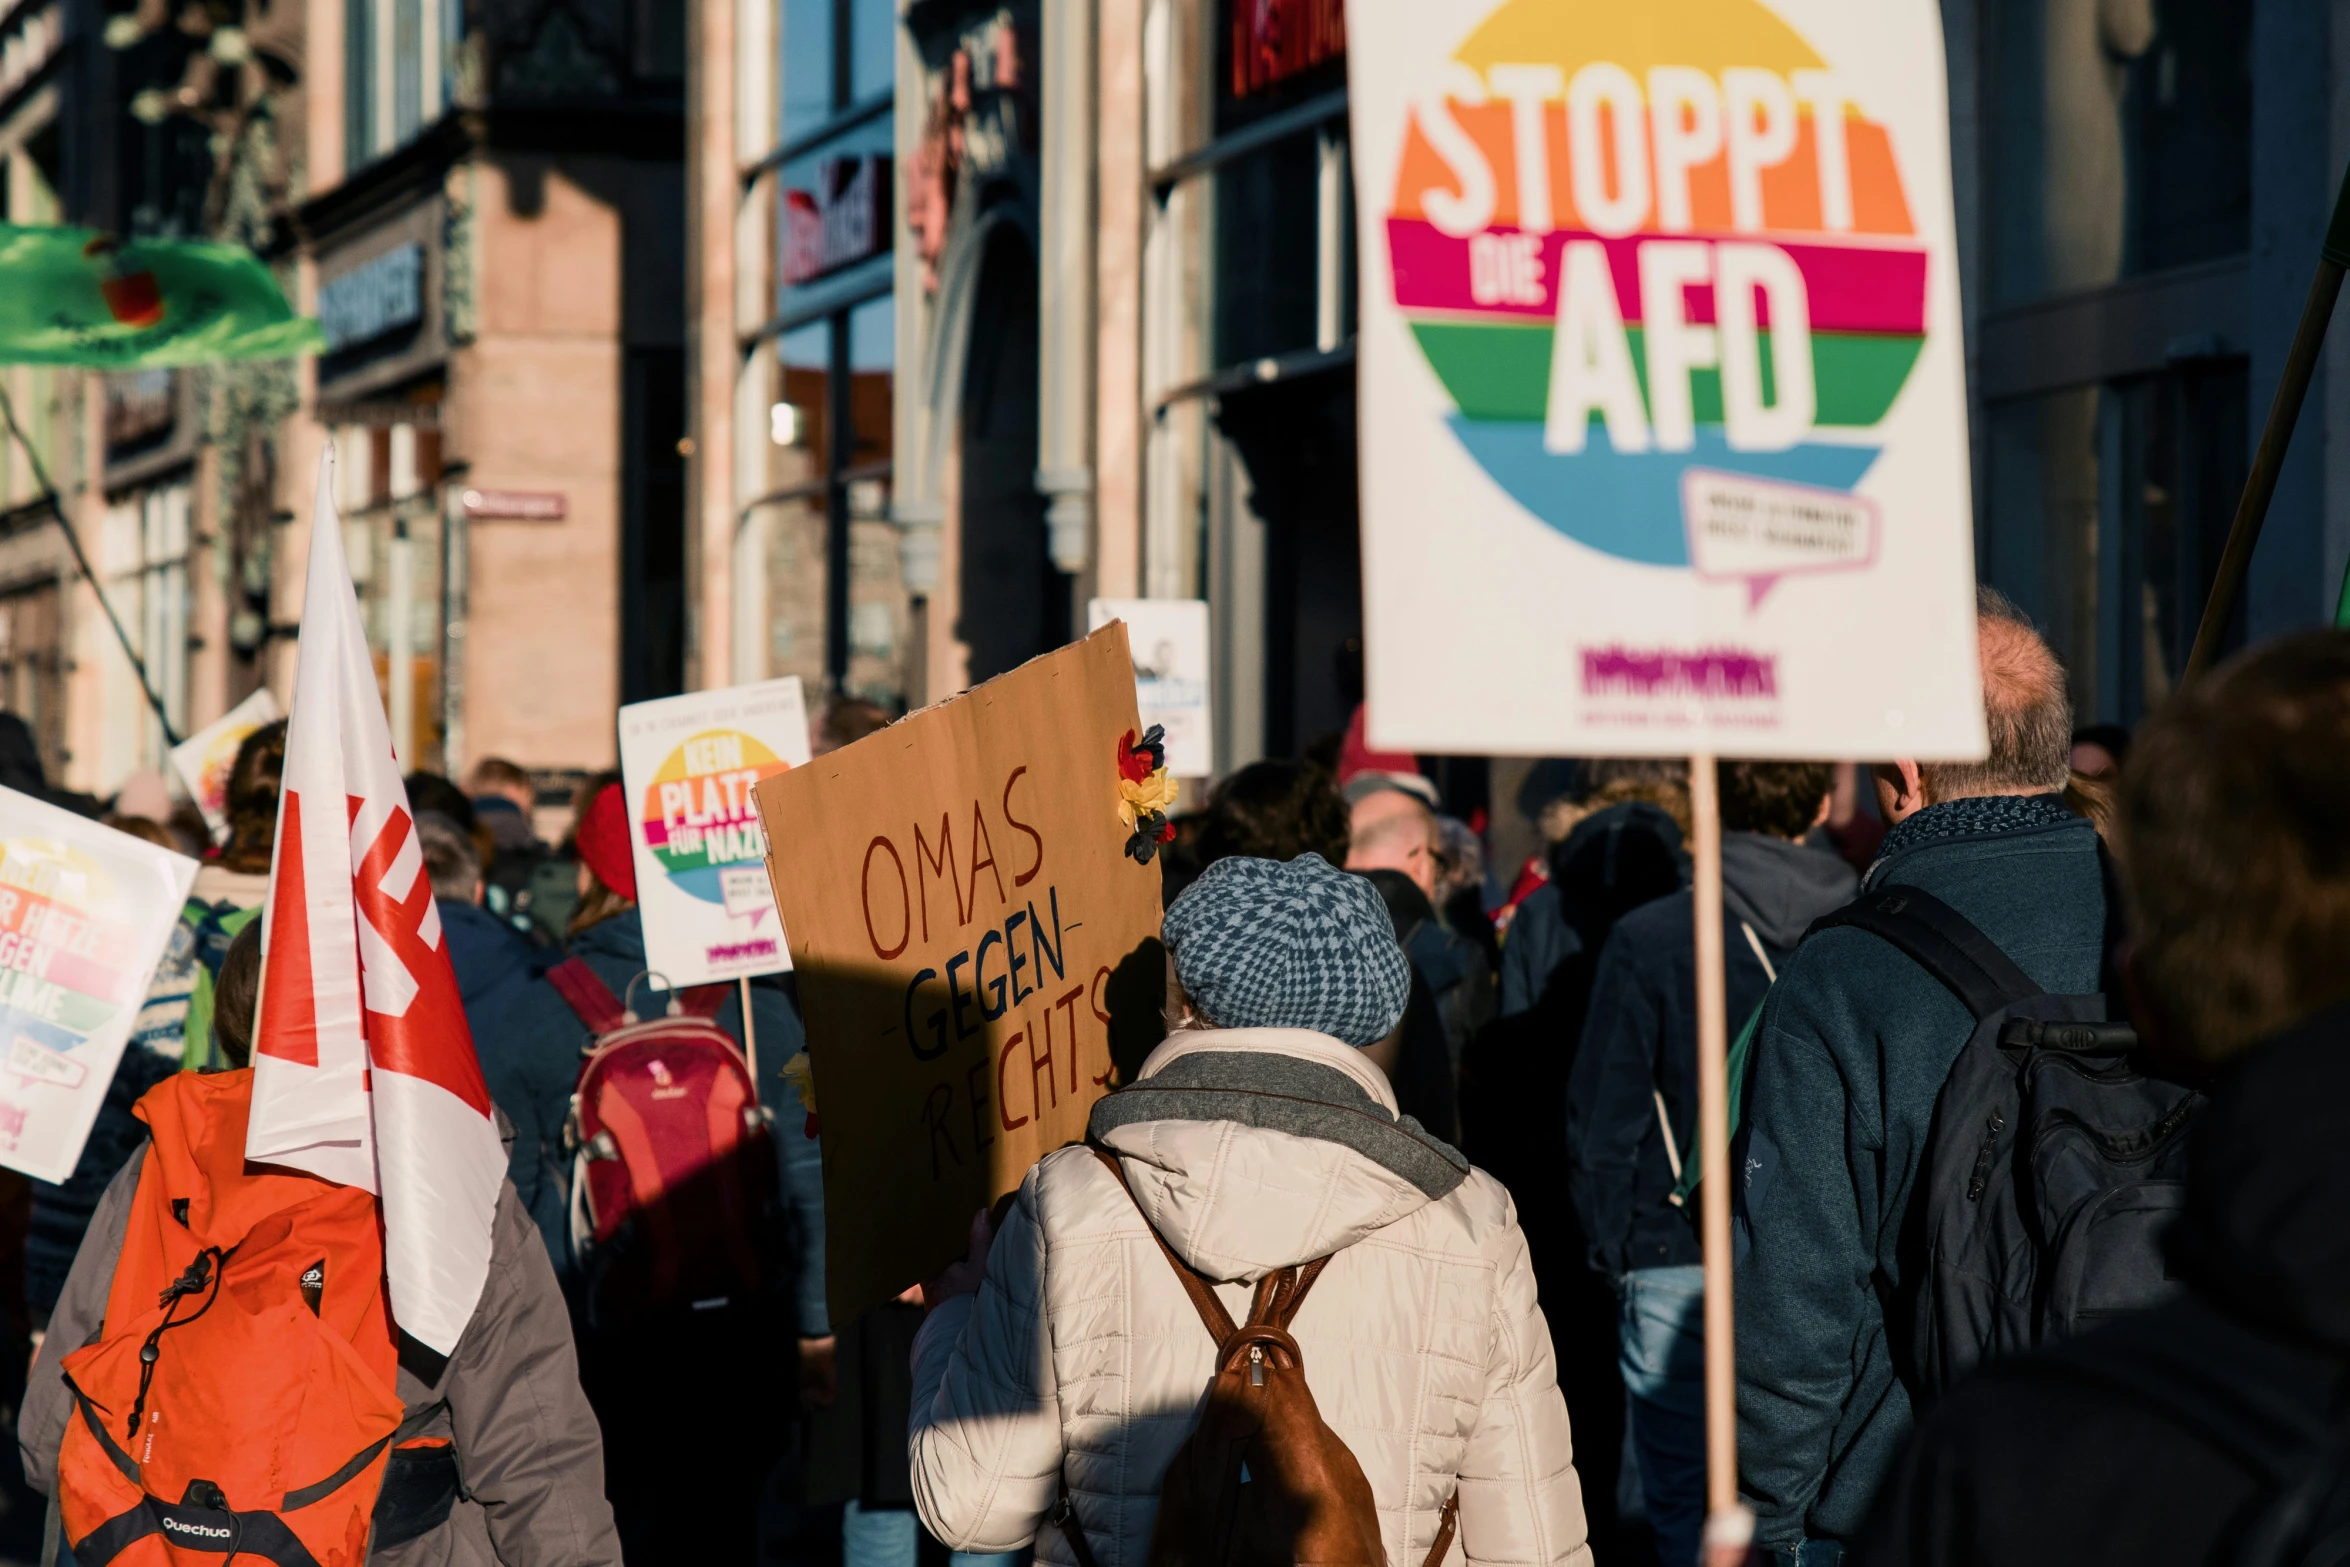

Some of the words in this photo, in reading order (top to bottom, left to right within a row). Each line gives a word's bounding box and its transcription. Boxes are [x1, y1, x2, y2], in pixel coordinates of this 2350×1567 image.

[1416, 60, 1869, 237] STOPPT
[1469, 233, 1547, 305] DIE
[1544, 239, 1818, 453] AFD
[660, 770, 758, 831] PLATZ
[682, 733, 744, 778] KEIN
[861, 765, 1043, 960] OMAS
[920, 964, 1116, 1182] RECHTS
[163, 1517, 231, 1538] Quechua
